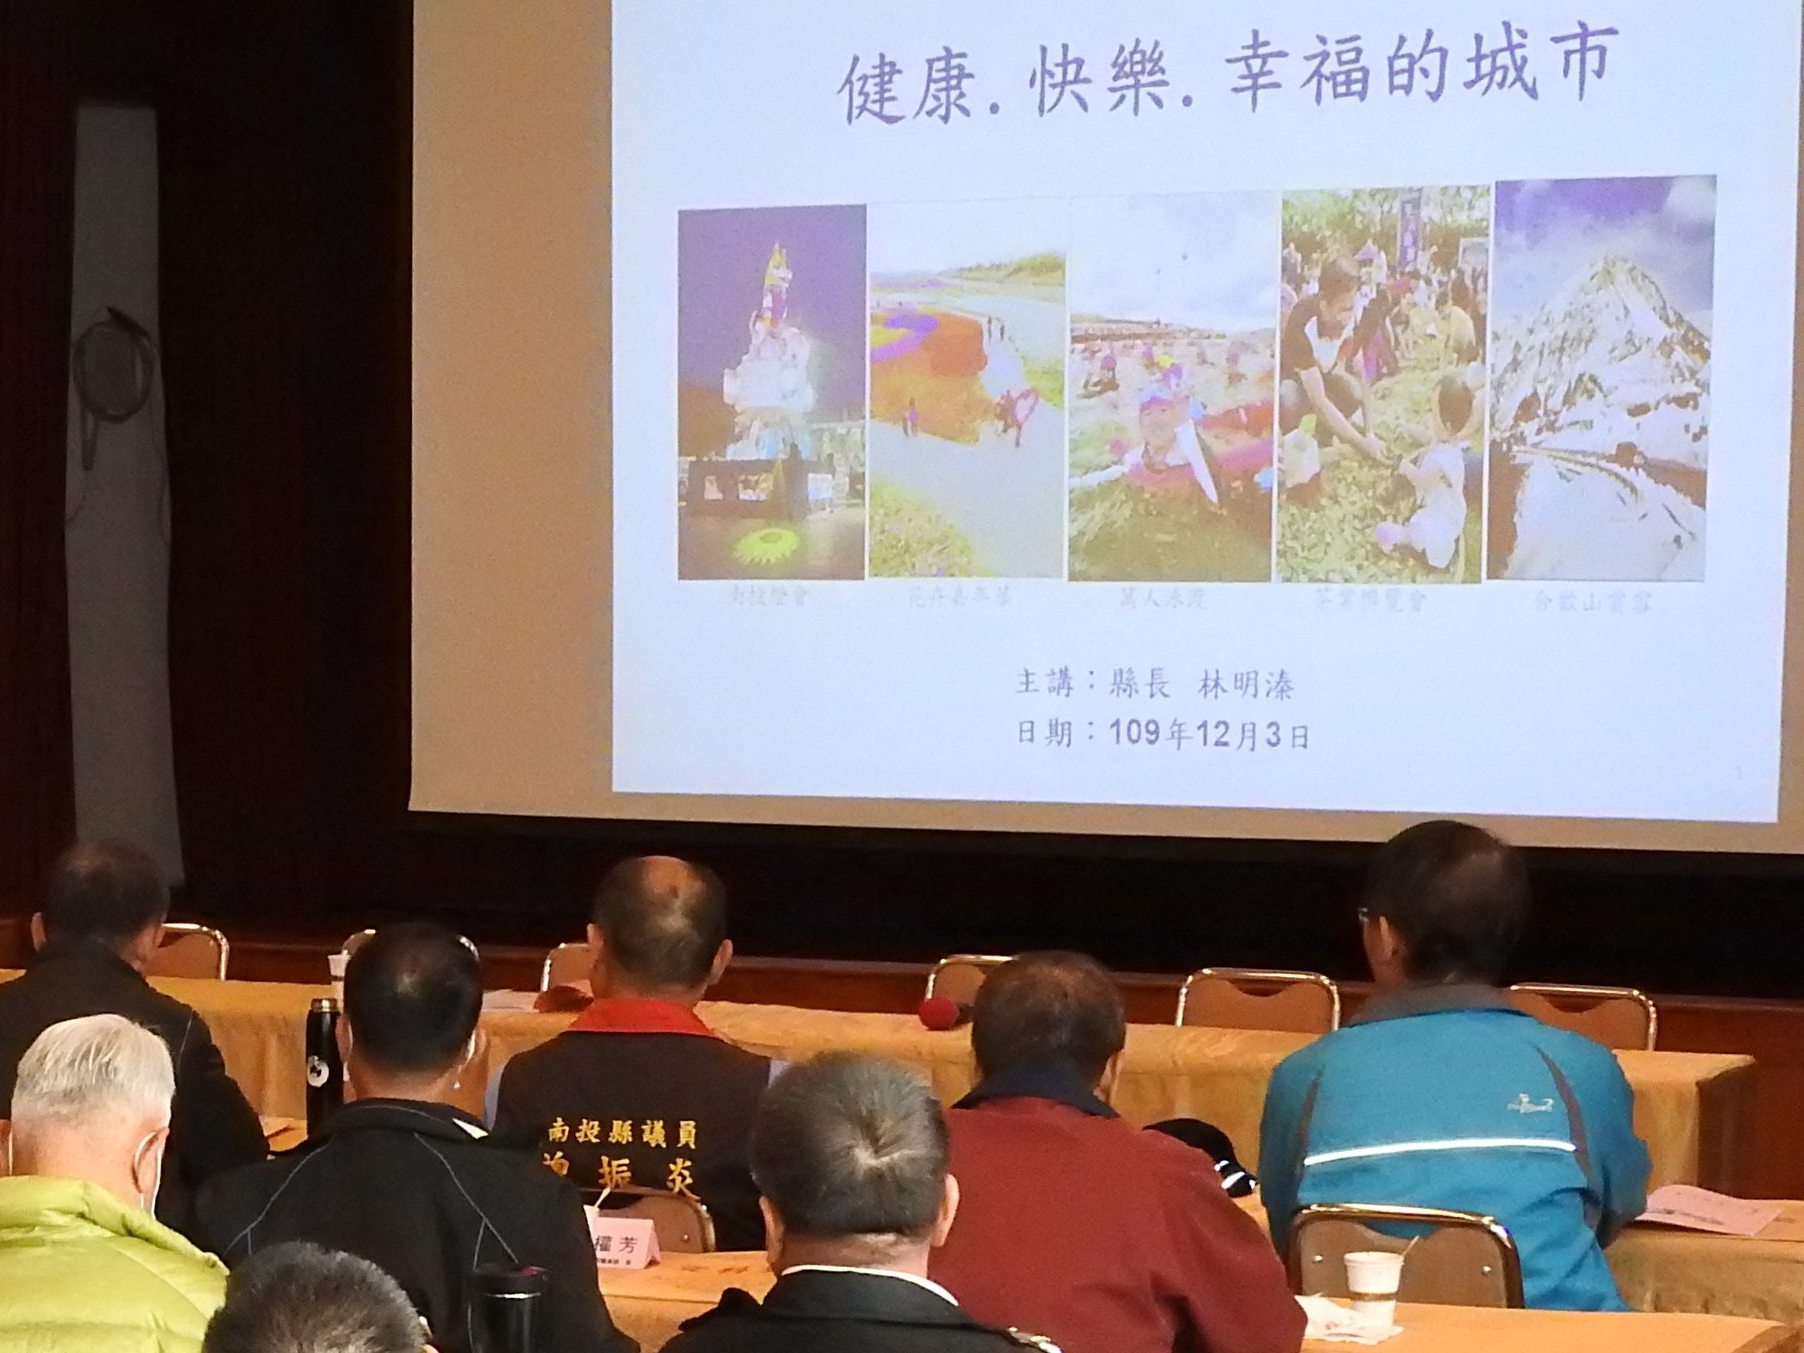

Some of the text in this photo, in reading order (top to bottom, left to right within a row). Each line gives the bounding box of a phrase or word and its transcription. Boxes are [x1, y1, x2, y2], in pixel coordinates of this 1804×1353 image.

[1197, 667, 1295, 701] 林明溱
[549, 1117, 696, 1149] 南投縣議員
